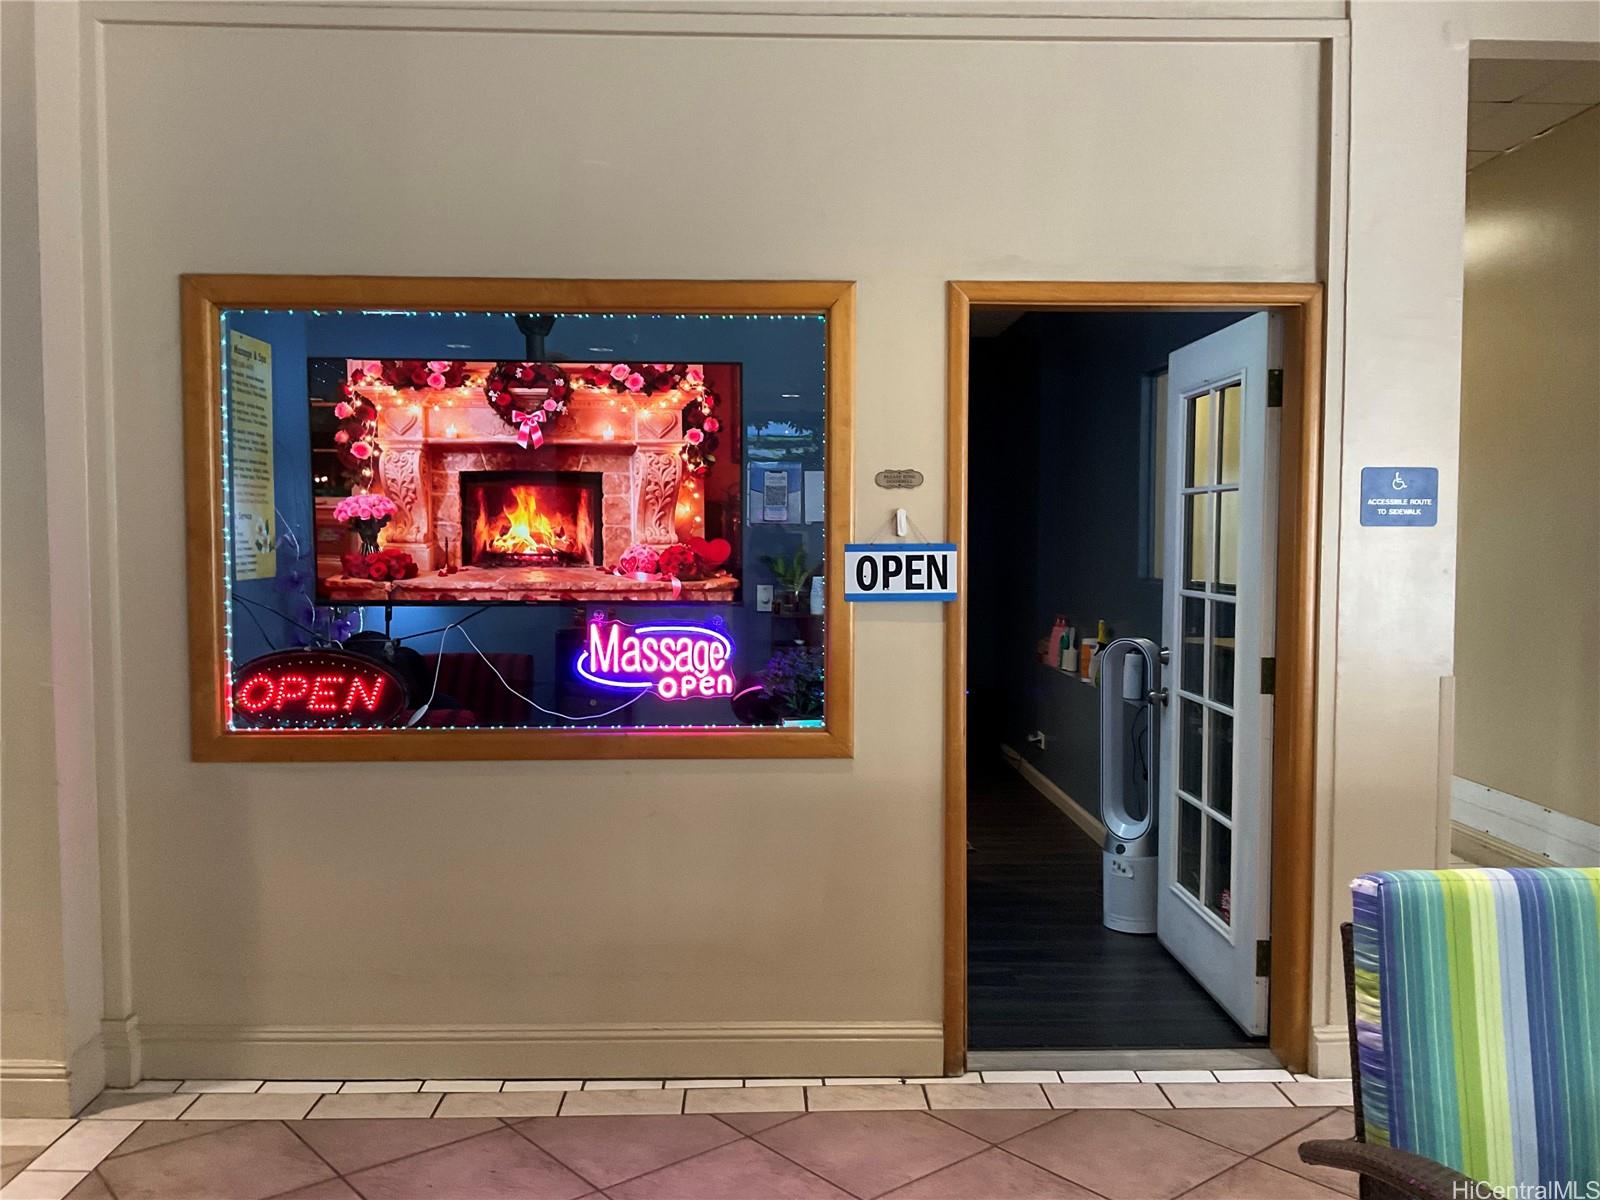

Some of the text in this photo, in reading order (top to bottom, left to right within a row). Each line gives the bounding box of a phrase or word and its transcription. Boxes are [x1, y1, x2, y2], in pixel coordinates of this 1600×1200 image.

[856, 554, 948, 591] OPEN
[589, 622, 726, 679] Massage
[239, 673, 385, 711] OPEN
